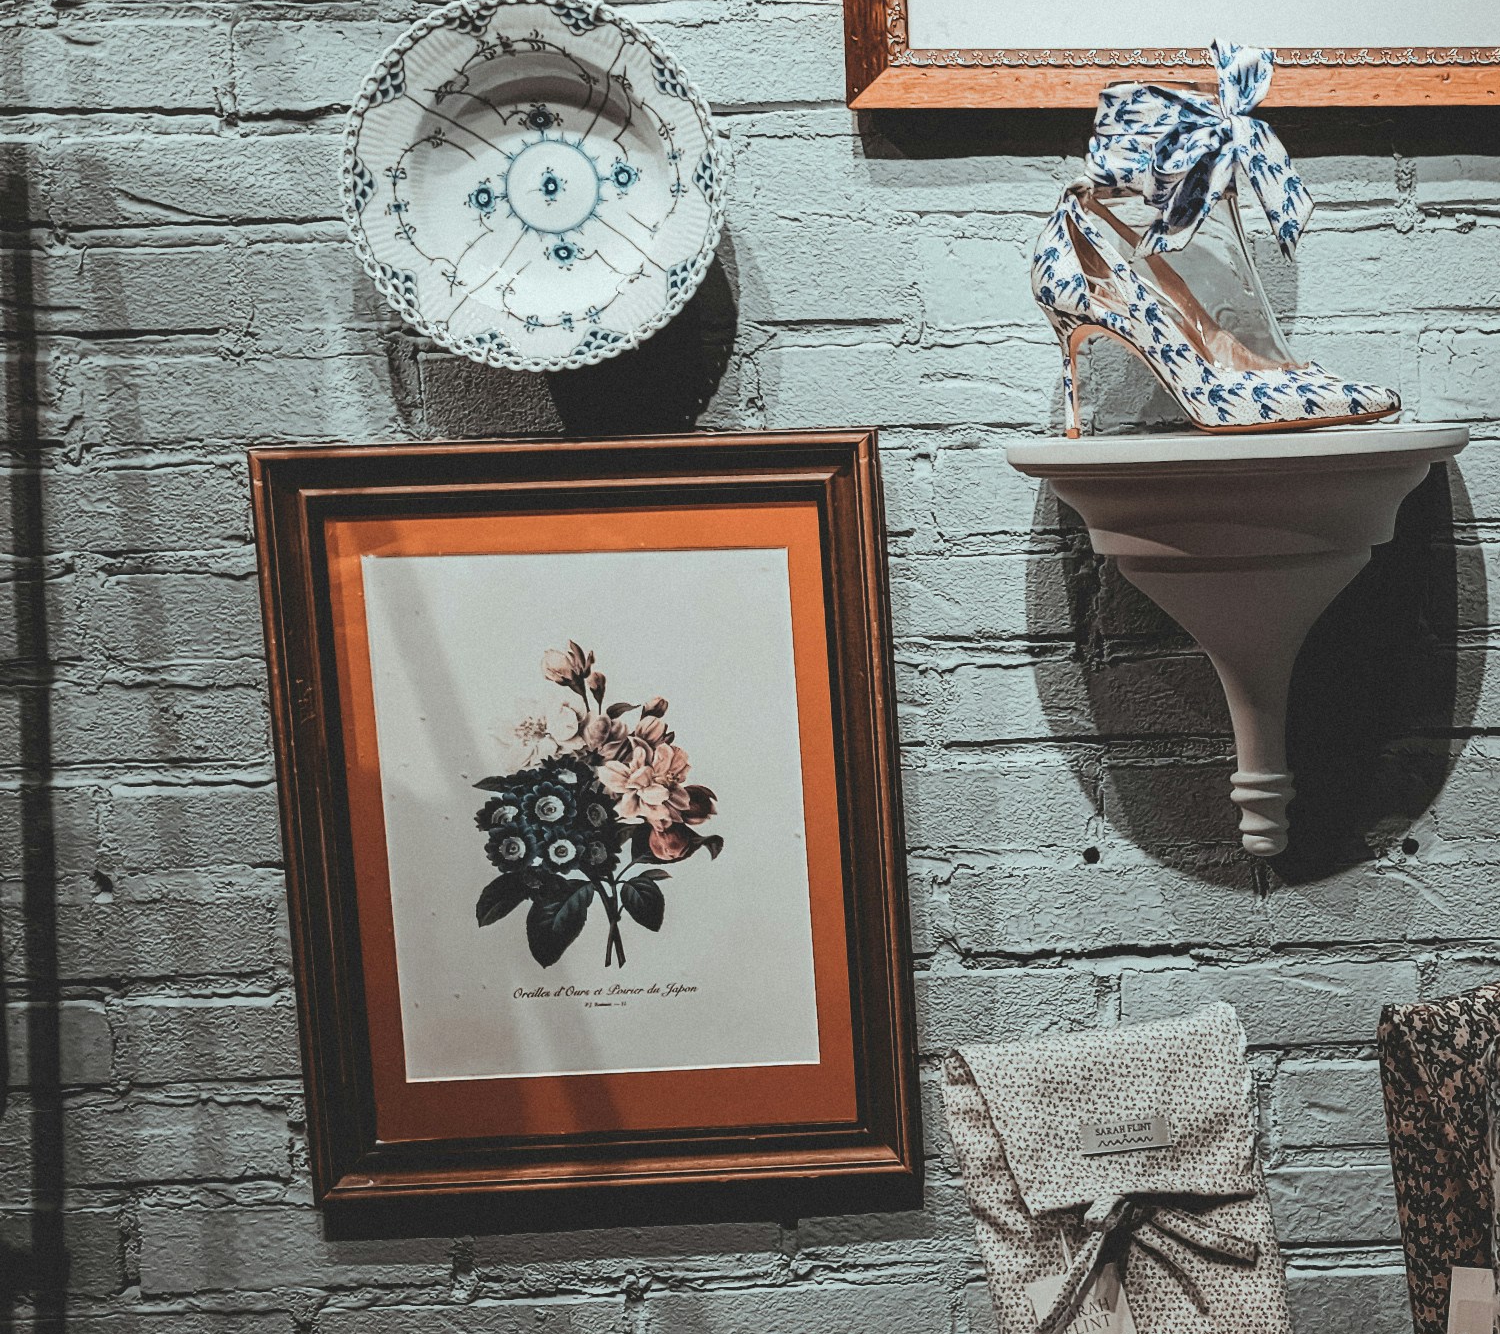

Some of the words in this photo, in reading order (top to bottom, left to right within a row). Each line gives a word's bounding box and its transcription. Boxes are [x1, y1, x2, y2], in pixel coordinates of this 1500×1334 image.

[593, 987, 603, 996] et
[646, 982, 660, 995] du
[660, 982, 699, 998] Japon
[1095, 1124, 1125, 1136] SARAH
[1126, 1122, 1152, 1133] FLINT
